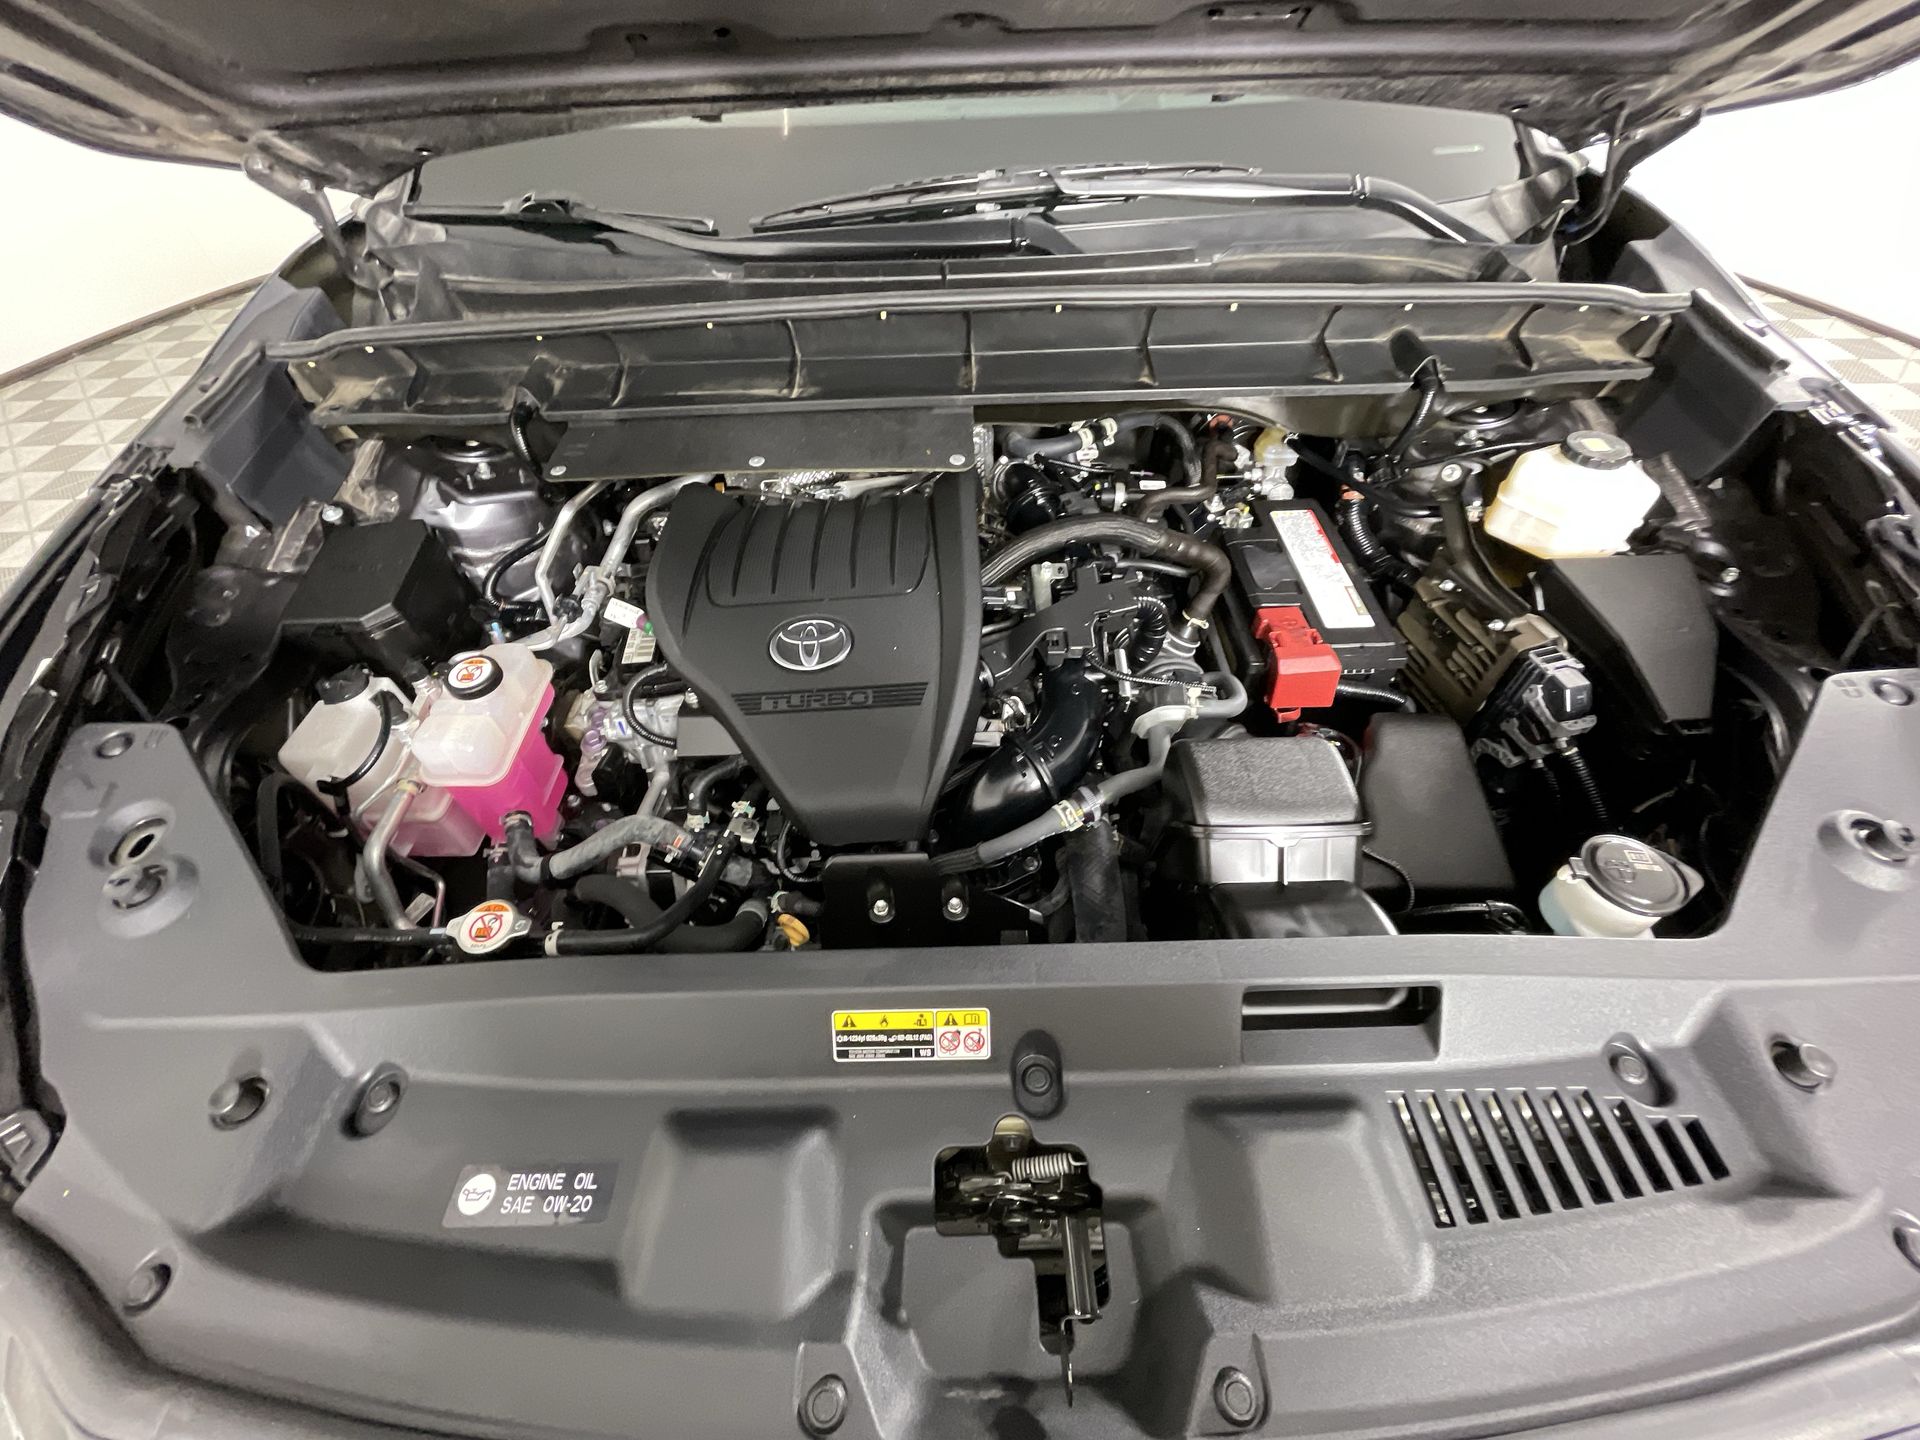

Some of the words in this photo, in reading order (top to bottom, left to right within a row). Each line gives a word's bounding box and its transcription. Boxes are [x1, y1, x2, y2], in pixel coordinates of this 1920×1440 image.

[762, 690, 871, 710] TURBO
[506, 1173, 566, 1191] ENGINE
[573, 1172, 597, 1190] OIL
[500, 1196, 535, 1214] SAE
[543, 1195, 593, 1213] 0W-20
